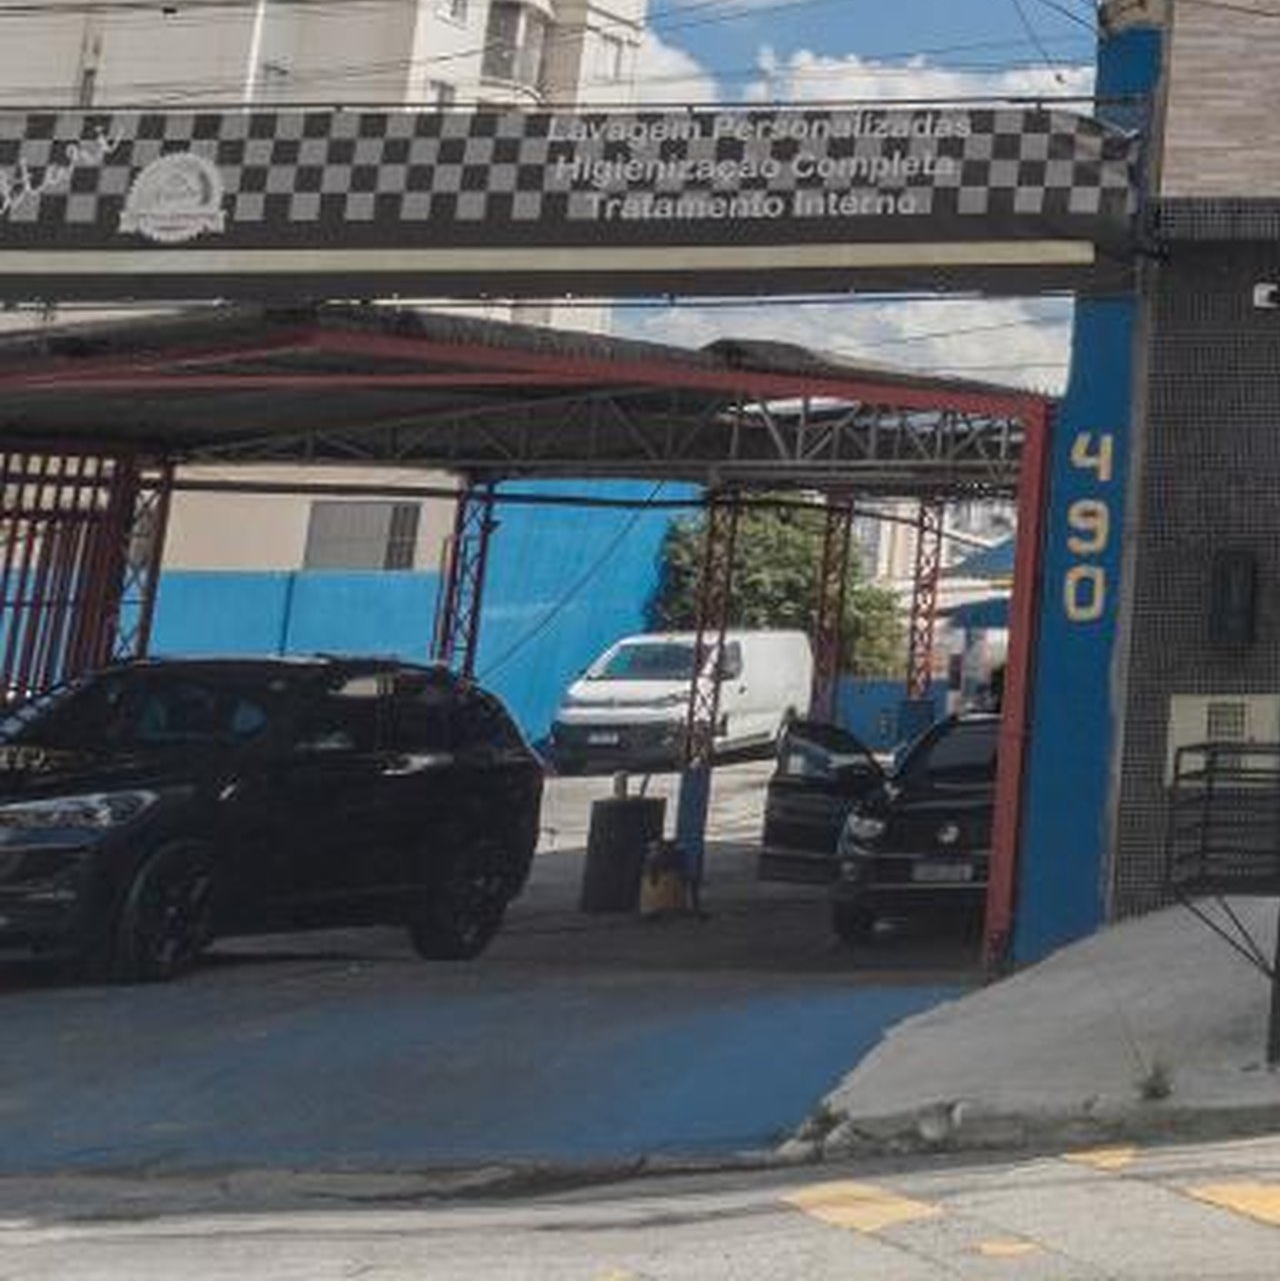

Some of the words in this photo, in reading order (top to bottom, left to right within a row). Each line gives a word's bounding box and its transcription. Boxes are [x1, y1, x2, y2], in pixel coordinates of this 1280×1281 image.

[548, 116, 702, 151] Lavagem
[714, 112, 972, 141] Personalizadas
[792, 148, 958, 183] Completa
[588, 192, 784, 218] Tratamento
[795, 190, 917, 216] Interno
[1064, 431, 1114, 622] 490
